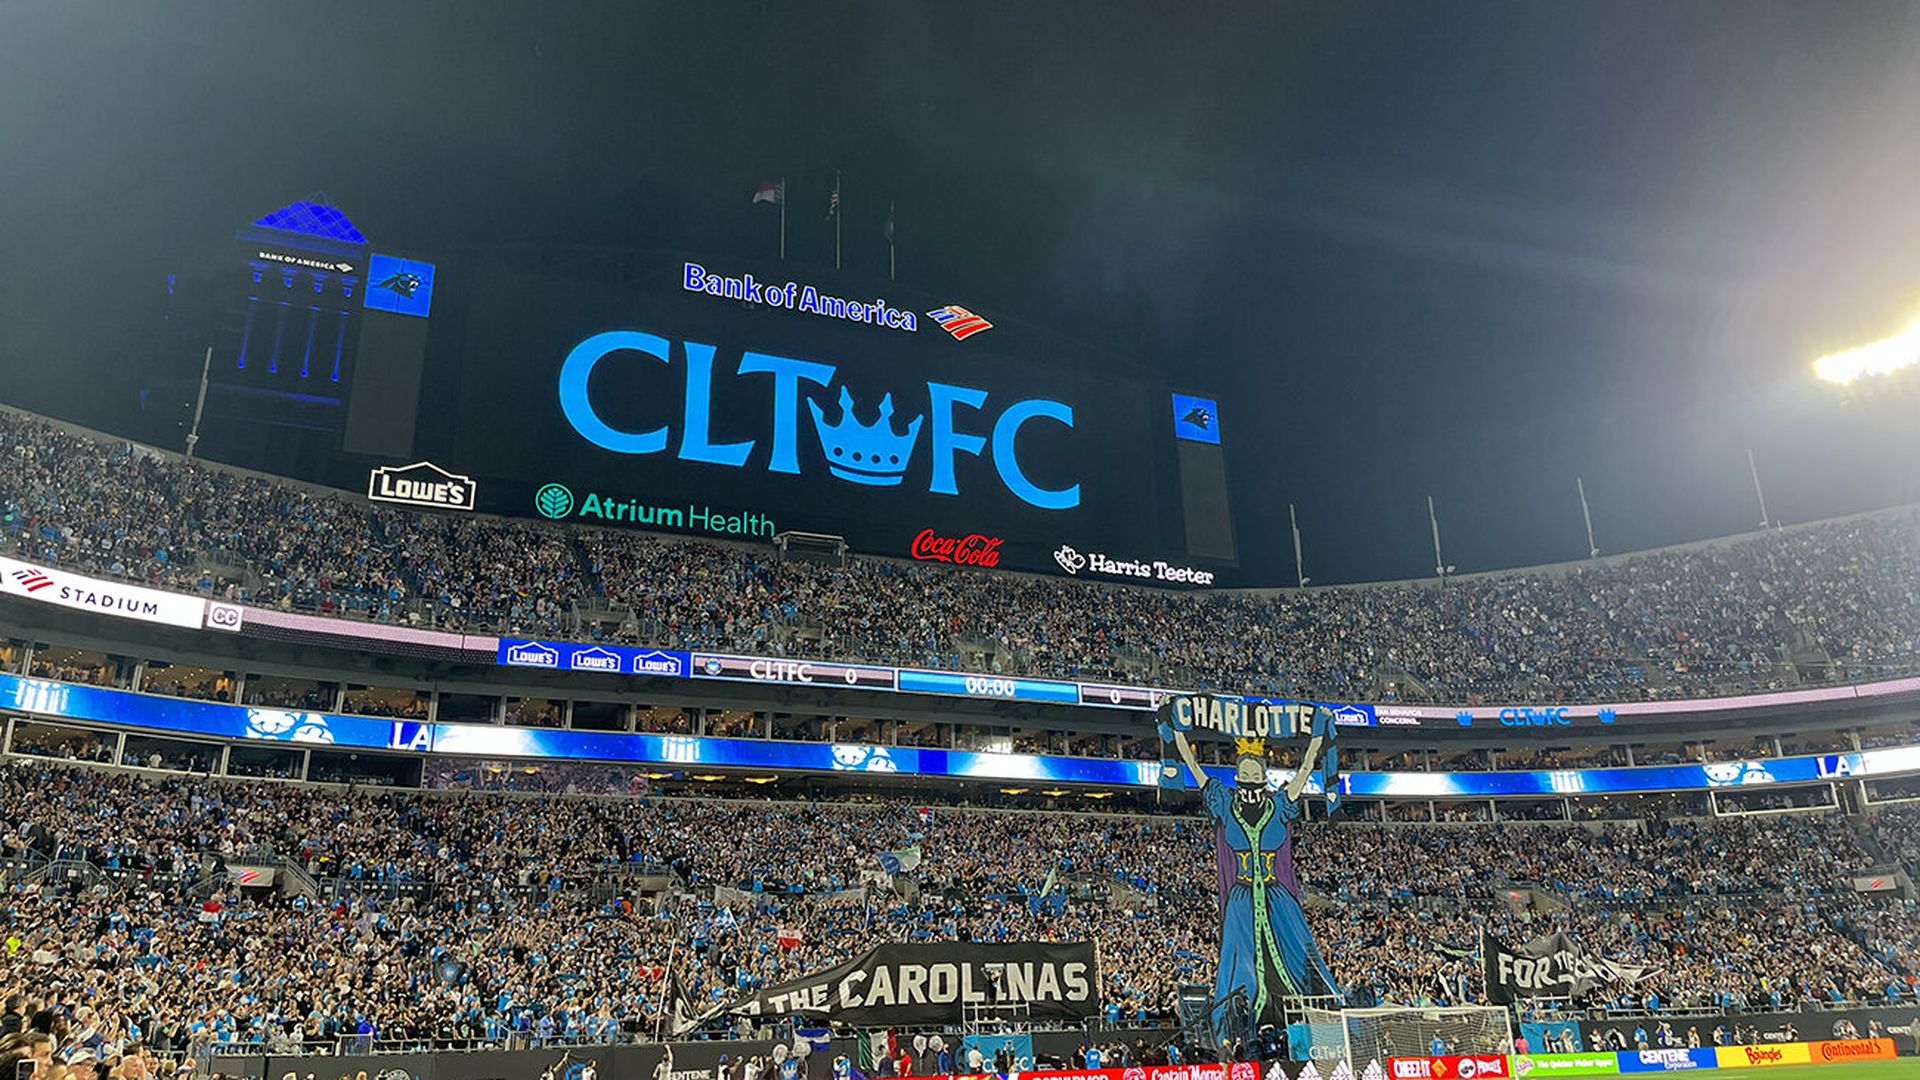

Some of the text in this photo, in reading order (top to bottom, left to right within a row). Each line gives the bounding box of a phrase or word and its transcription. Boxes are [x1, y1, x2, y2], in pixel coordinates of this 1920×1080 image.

[260, 252, 283, 261] BANK
[297, 258, 335, 270] AMERICA
[684, 262, 917, 332] Bank of America
[380, 474, 465, 504] LOWE'S
[579, 493, 775, 536] Atrium Health
[1088, 553, 1214, 585] Harris Teeter
[60, 586, 158, 615] STADIUM
[513, 650, 676, 672] LOWE'S LOWE'S LOWE'S
[965, 677, 1015, 696] 00:00
[1110, 690, 1121, 704] 0
[1177, 695, 1314, 737] CHARLOTTE
[387, 722, 431, 751] LA
[1498, 952, 1557, 989] FOR
[768, 984, 830, 1013] THE
[1639, 1049, 1690, 1064] CENTENE
[1745, 1046, 1782, 1064] Bojangles
[1821, 1042, 1873, 1061] Continental
